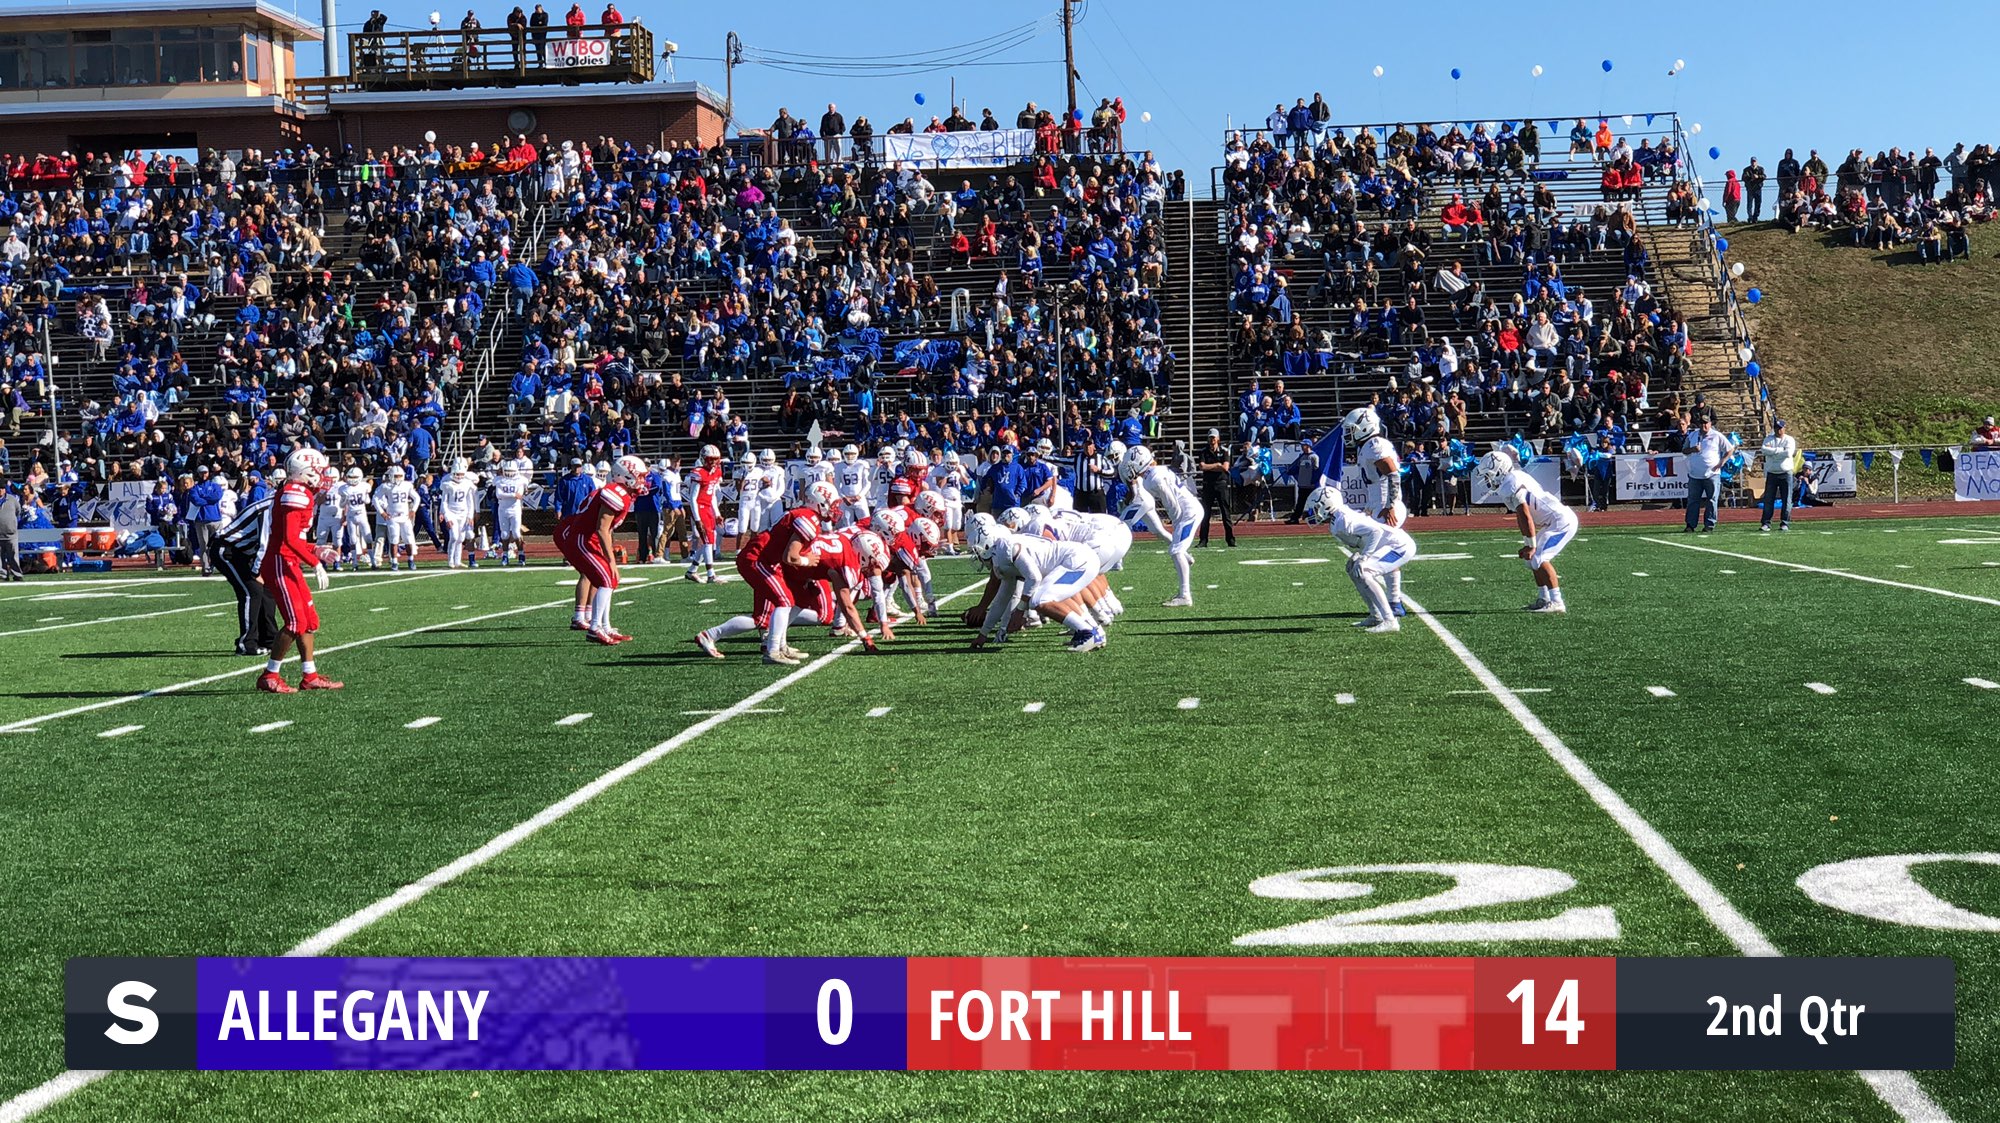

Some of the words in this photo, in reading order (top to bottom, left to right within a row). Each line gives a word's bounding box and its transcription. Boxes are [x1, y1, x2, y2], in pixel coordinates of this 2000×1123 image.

[551, 40, 605, 57] WTBO
[566, 56, 604, 67] Oldies
[1961, 454, 2000, 471] BEA
[743, 478, 758, 492] 23
[843, 473, 859, 486] 63
[1626, 481, 1655, 491] First
[392, 492, 407, 504] 32
[454, 491, 465, 502] 12
[1233, 861, 1621, 947] 2
